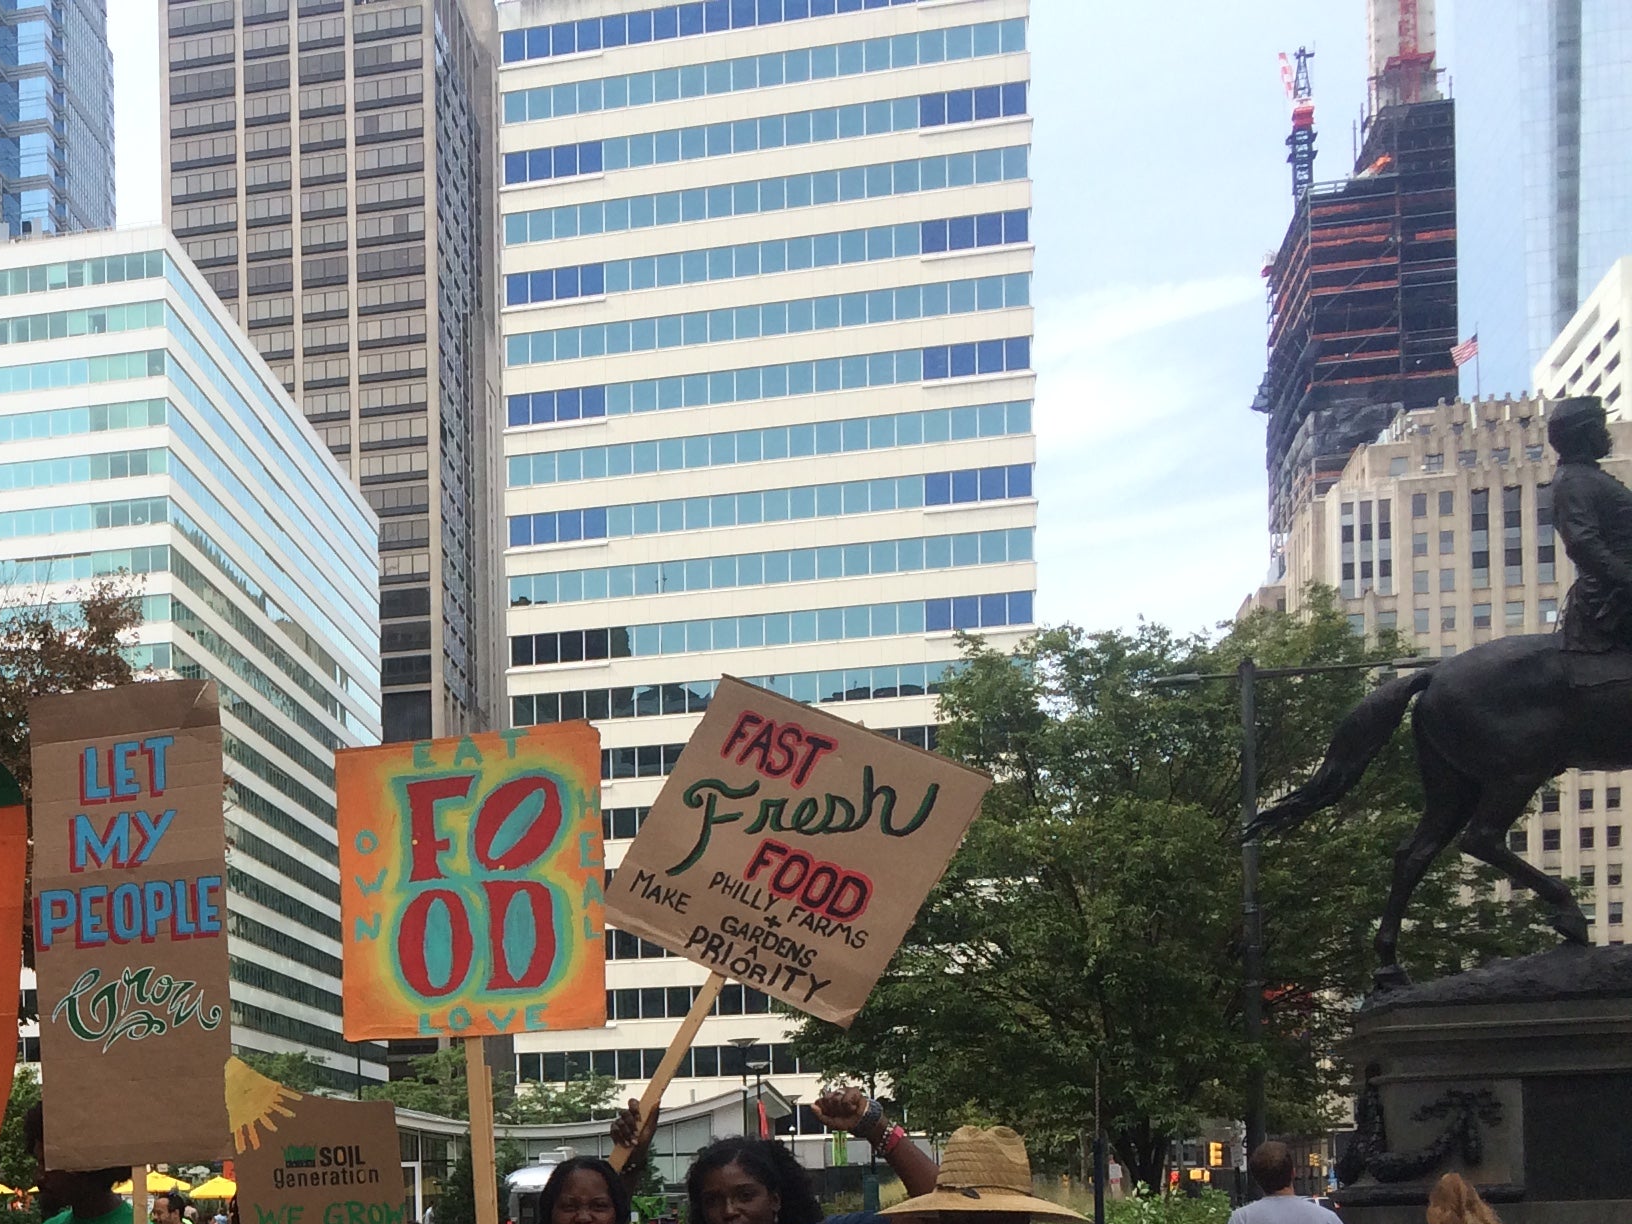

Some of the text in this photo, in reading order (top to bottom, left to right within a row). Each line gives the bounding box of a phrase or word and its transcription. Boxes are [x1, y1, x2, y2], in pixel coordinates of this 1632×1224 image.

[79, 736, 175, 806] LET
[413, 728, 530, 768] EAT
[720, 709, 840, 790] FAST
[69, 809, 177, 873] MY
[576, 787, 604, 939] HEAL
[629, 869, 691, 915] MAKE
[709, 871, 869, 949] PHILLY FARMS
[743, 838, 873, 923] FOOD
[34, 876, 223, 952] PEOPLE
[720, 915, 818, 968] GARDENS
[684, 925, 831, 1003] PRIORITY
[746, 947, 758, 957] A
[419, 1003, 549, 1036] LOVE
[273, 1167, 379, 1189] generation
[319, 1145, 365, 1168] SOIL
